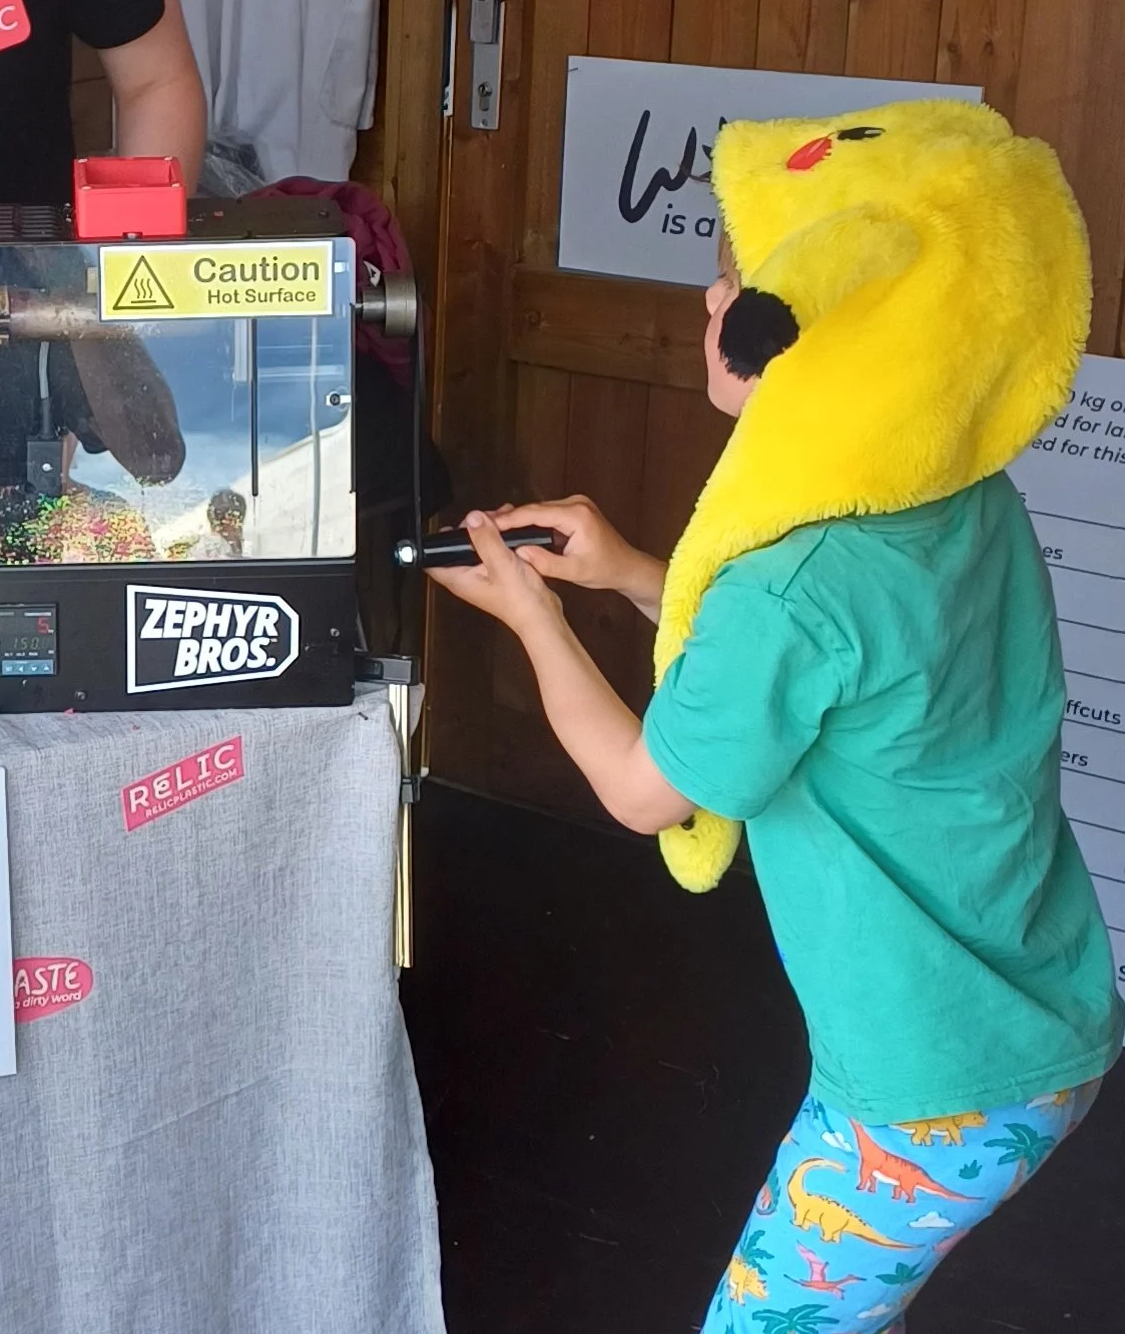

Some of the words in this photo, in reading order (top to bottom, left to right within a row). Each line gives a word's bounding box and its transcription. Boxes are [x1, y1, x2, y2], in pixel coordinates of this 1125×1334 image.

[661, 203, 687, 235] is
[193, 256, 320, 284] Caution
[207, 289, 241, 305] Hot
[245, 287, 317, 304] Surface
[1080, 391, 1106, 412] kg
[1072, 415, 1101, 434] for
[1060, 439, 1089, 457] for
[140, 598, 280, 639] ZEPHYR
[174, 636, 277, 677] BROS.
[129, 744, 235, 814] RELIC
[145, 768, 238, 818] RELICPLASTIC.COM
[22, 995, 49, 1007] dirty
[51, 989, 83, 1004] word
